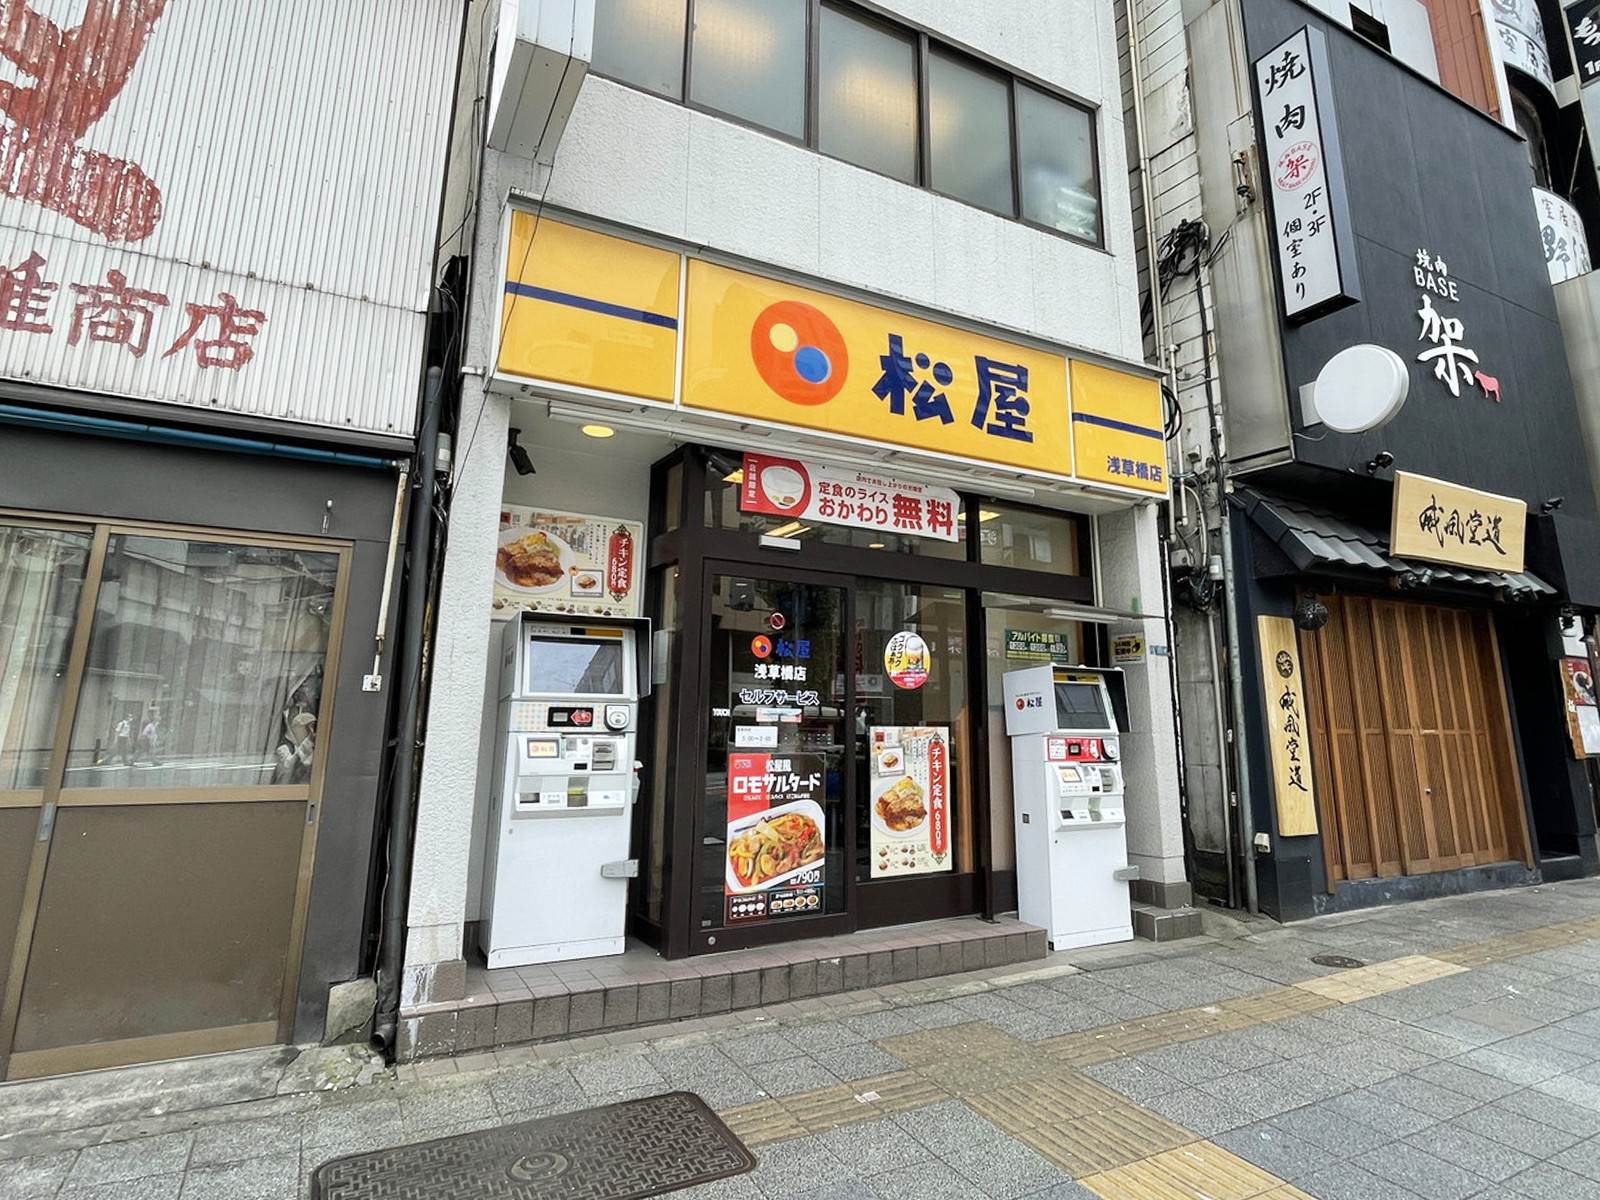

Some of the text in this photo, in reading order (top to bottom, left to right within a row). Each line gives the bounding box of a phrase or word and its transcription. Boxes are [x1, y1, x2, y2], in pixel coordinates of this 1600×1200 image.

[1264, 51, 1306, 139] 焼肉
[1282, 217, 1307, 301] 個室あり
[1415, 248, 1448, 277] 焼肉
[1413, 265, 1460, 302] BASE
[1416, 293, 1480, 398] 架
[871, 333, 1034, 444] 松屋
[1106, 455, 1163, 484] 浅草橋店
[818, 480, 889, 505] 定食のライス
[617, 537, 630, 589] チキン定食
[775, 638, 811, 660] 松屋
[754, 663, 807, 682] 浅草橋店
[739, 688, 820, 706] セルフサービス
[732, 772, 822, 794] ロモサルタード
[931, 747, 943, 810] チキン定食
